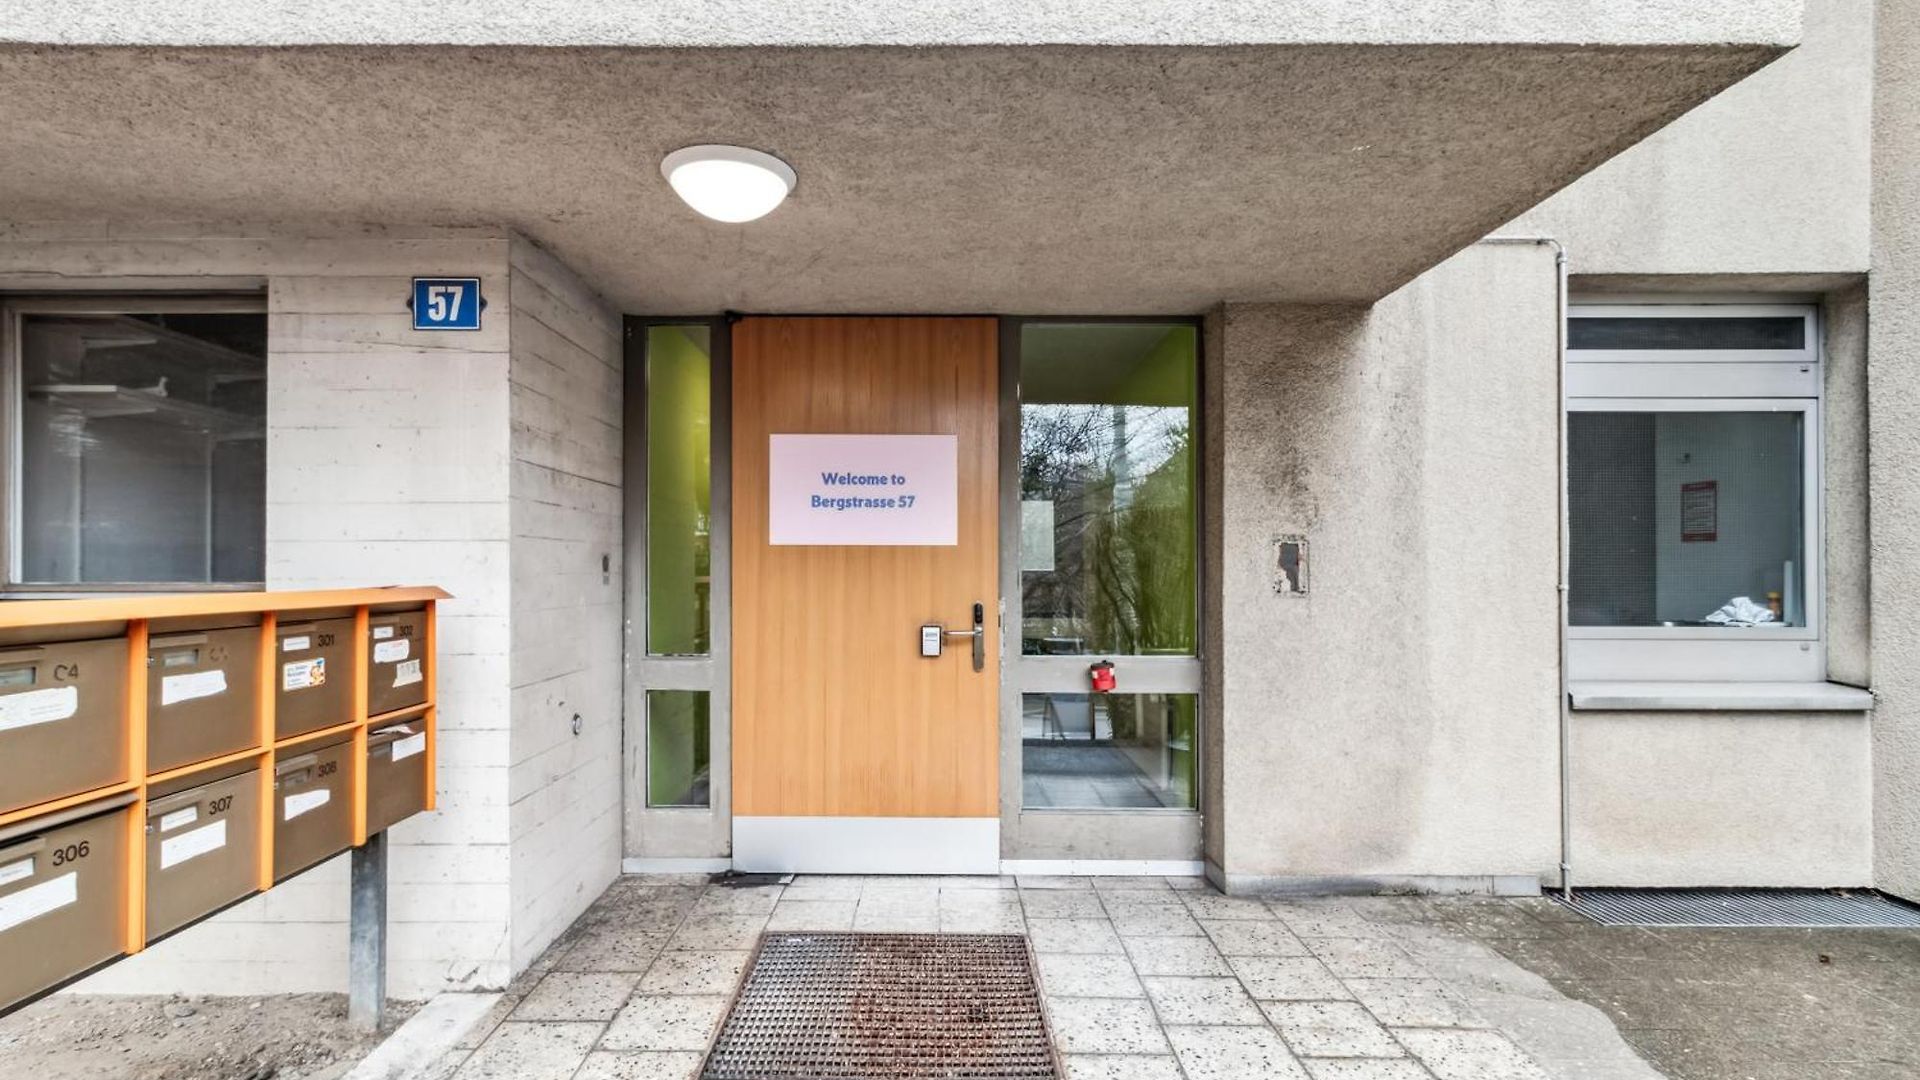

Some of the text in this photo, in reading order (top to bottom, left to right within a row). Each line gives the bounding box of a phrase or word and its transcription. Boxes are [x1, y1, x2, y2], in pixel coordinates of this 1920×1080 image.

[428, 286, 463, 321] 57
[821, 472, 905, 485] Welcome to
[811, 495, 916, 511] Bergstrasse 57
[318, 634, 335, 647] 301
[53, 664, 79, 681] C4
[208, 795, 233, 816] 307
[52, 840, 90, 867] 306
